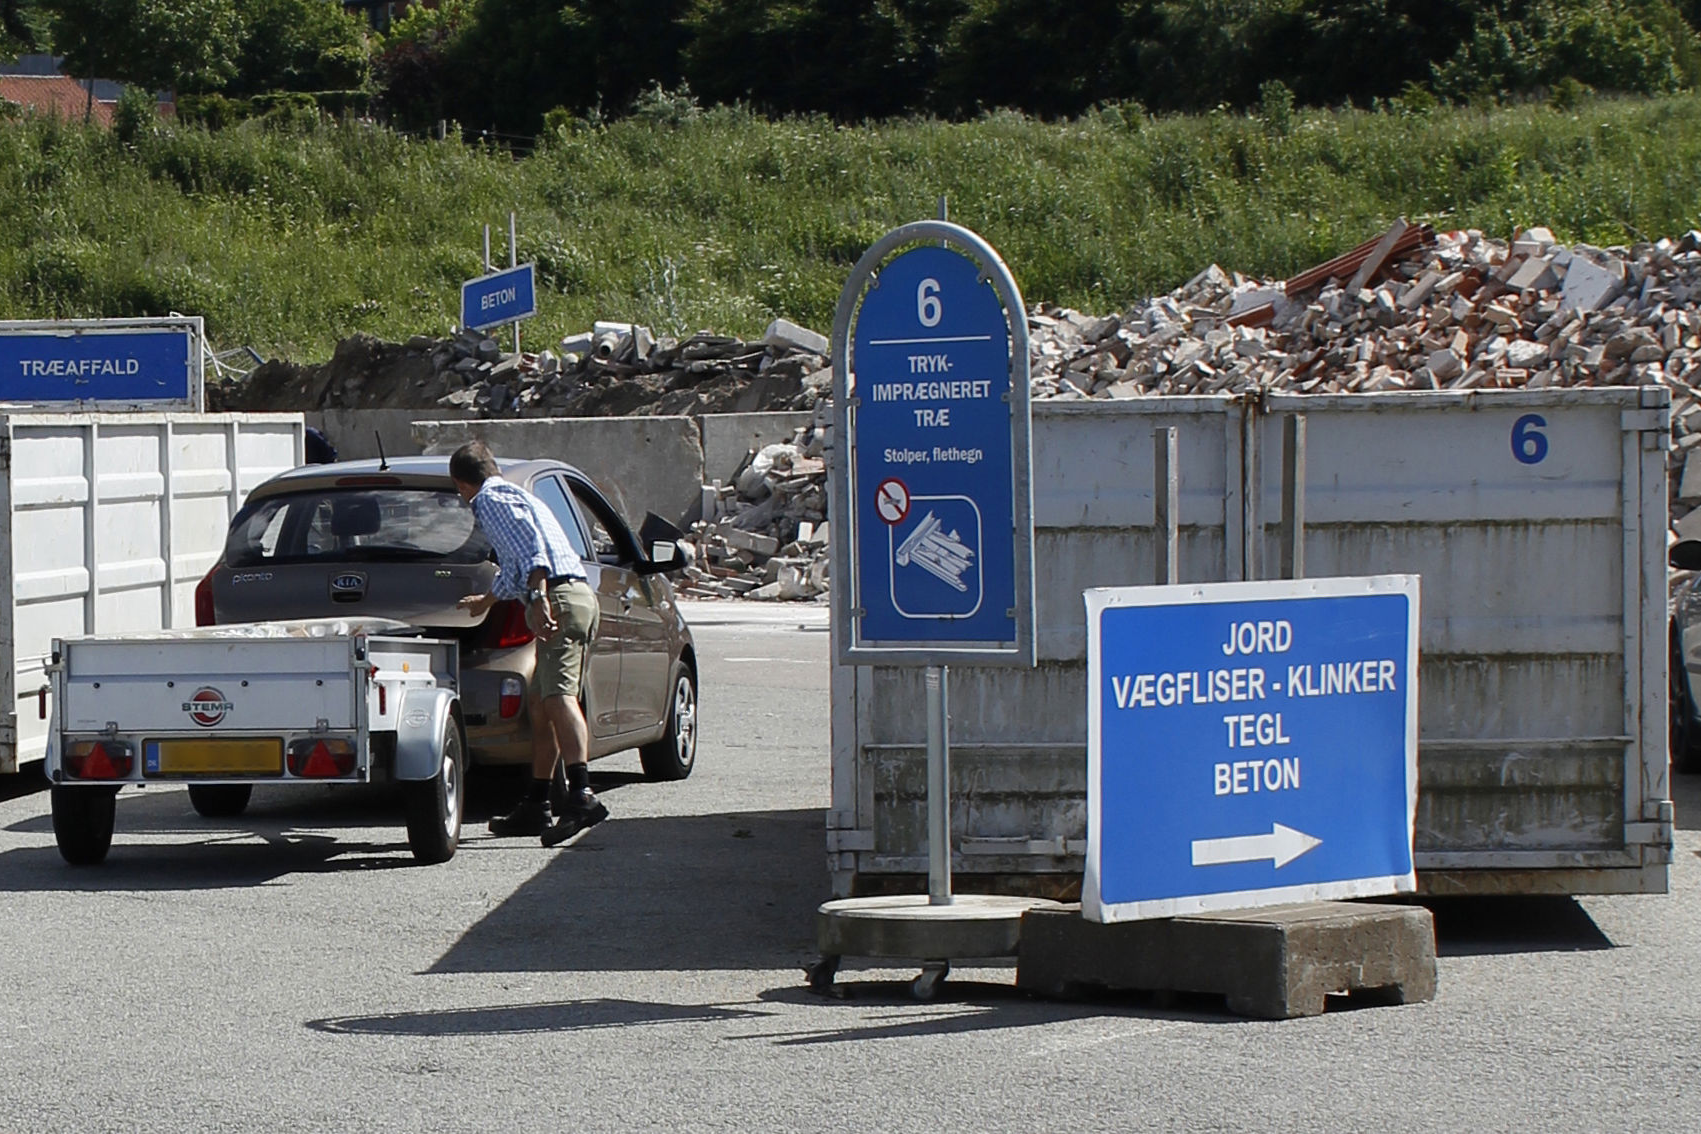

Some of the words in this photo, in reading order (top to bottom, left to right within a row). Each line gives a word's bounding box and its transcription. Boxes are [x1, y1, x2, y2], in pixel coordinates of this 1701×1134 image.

[481, 287, 516, 310] BETON
[916, 278, 942, 327] 6
[19, 358, 139, 376] TRÆAFFALD
[907, 354, 953, 373] TRYK-
[872, 380, 991, 401] IMPRÆGNERET
[913, 409, 950, 427] TRÆ
[1510, 413, 1549, 465] 6
[883, 447, 931, 465] Stolper,
[932, 447, 983, 465] flethegn
[336, 577, 359, 587] KIA
[1222, 620, 1292, 655] JORD
[1111, 667, 1266, 709] VÆGFLISER
[1272, 681, 1282, 691] -
[1287, 660, 1397, 698] KLINKER
[181, 702, 234, 711] STEMA
[1223, 713, 1290, 748] TEGL
[1214, 757, 1300, 796] BETON
